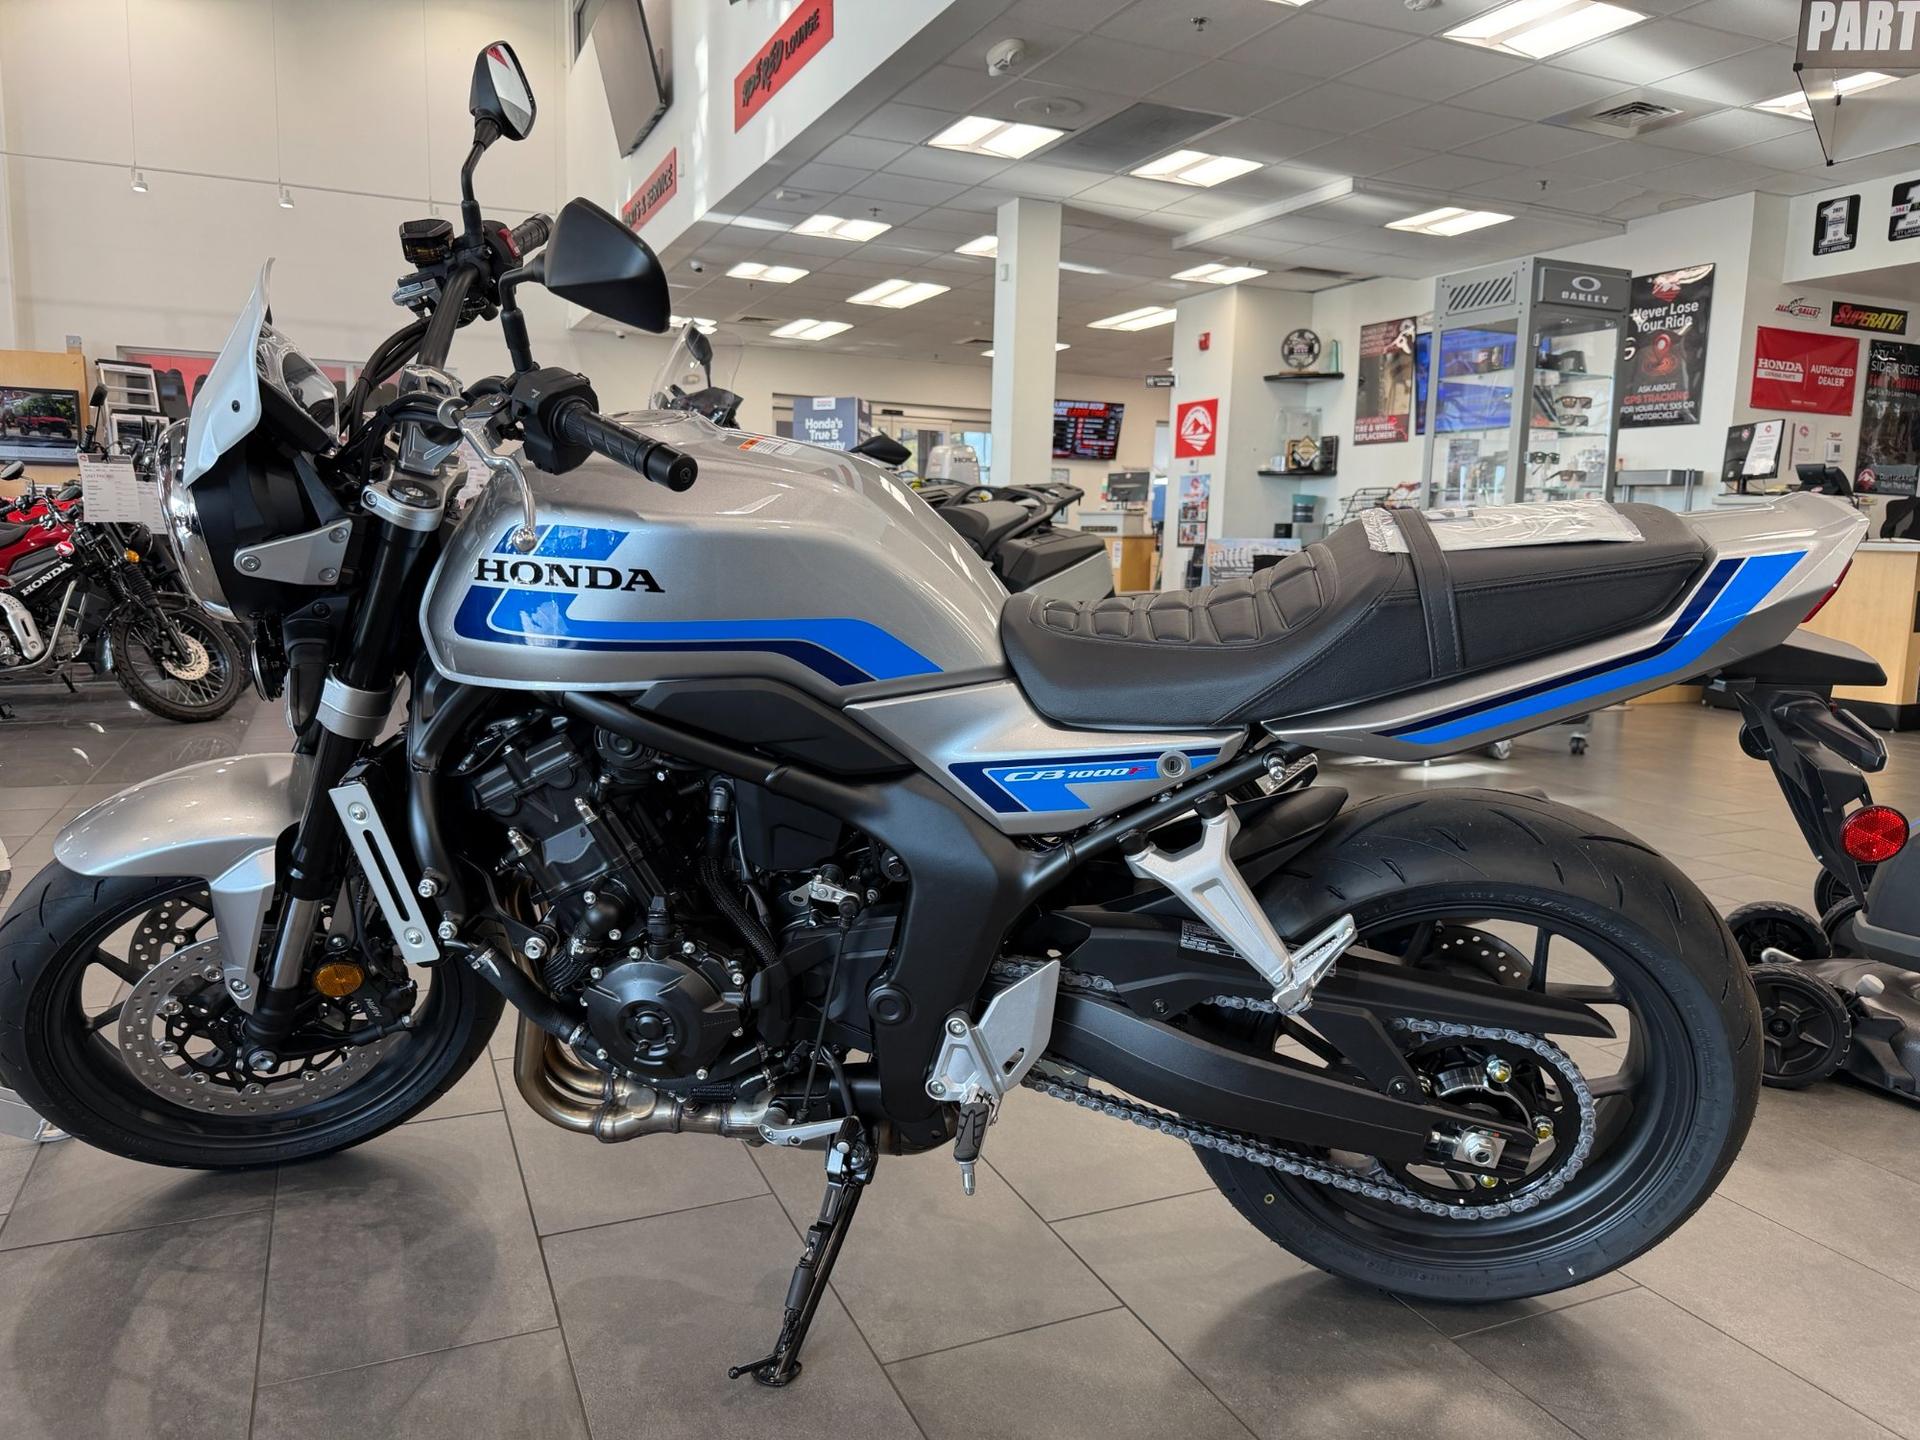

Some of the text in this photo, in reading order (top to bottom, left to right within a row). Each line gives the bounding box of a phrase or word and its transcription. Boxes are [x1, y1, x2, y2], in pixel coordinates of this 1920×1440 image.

[785, 8, 820, 60] LOUNGE
[647, 163, 673, 208] SERVICE
[1561, 290, 1609, 304] OAKLEY
[1632, 301, 1699, 321] Never Lose
[1636, 314, 1694, 333] Your Ride
[1757, 358, 1804, 373] HONDA
[1810, 364, 1854, 376] AUTHORIZED
[1871, 360, 1891, 373] SIDE
[1900, 364, 1919, 376] SIDE
[1638, 382, 1677, 392] ASK ABOUT
[1817, 376, 1845, 387] DEALER
[1623, 390, 1689, 405] GPS TRACKING
[1635, 404, 1653, 413] YOUR
[1683, 401, 1695, 410] OR
[805, 417, 843, 430] Honda's
[1633, 411, 1679, 421] MOTORCYCLE
[809, 429, 839, 440] True 5
[20, 562, 73, 597] HONDA
[474, 558, 665, 593] HONDA
